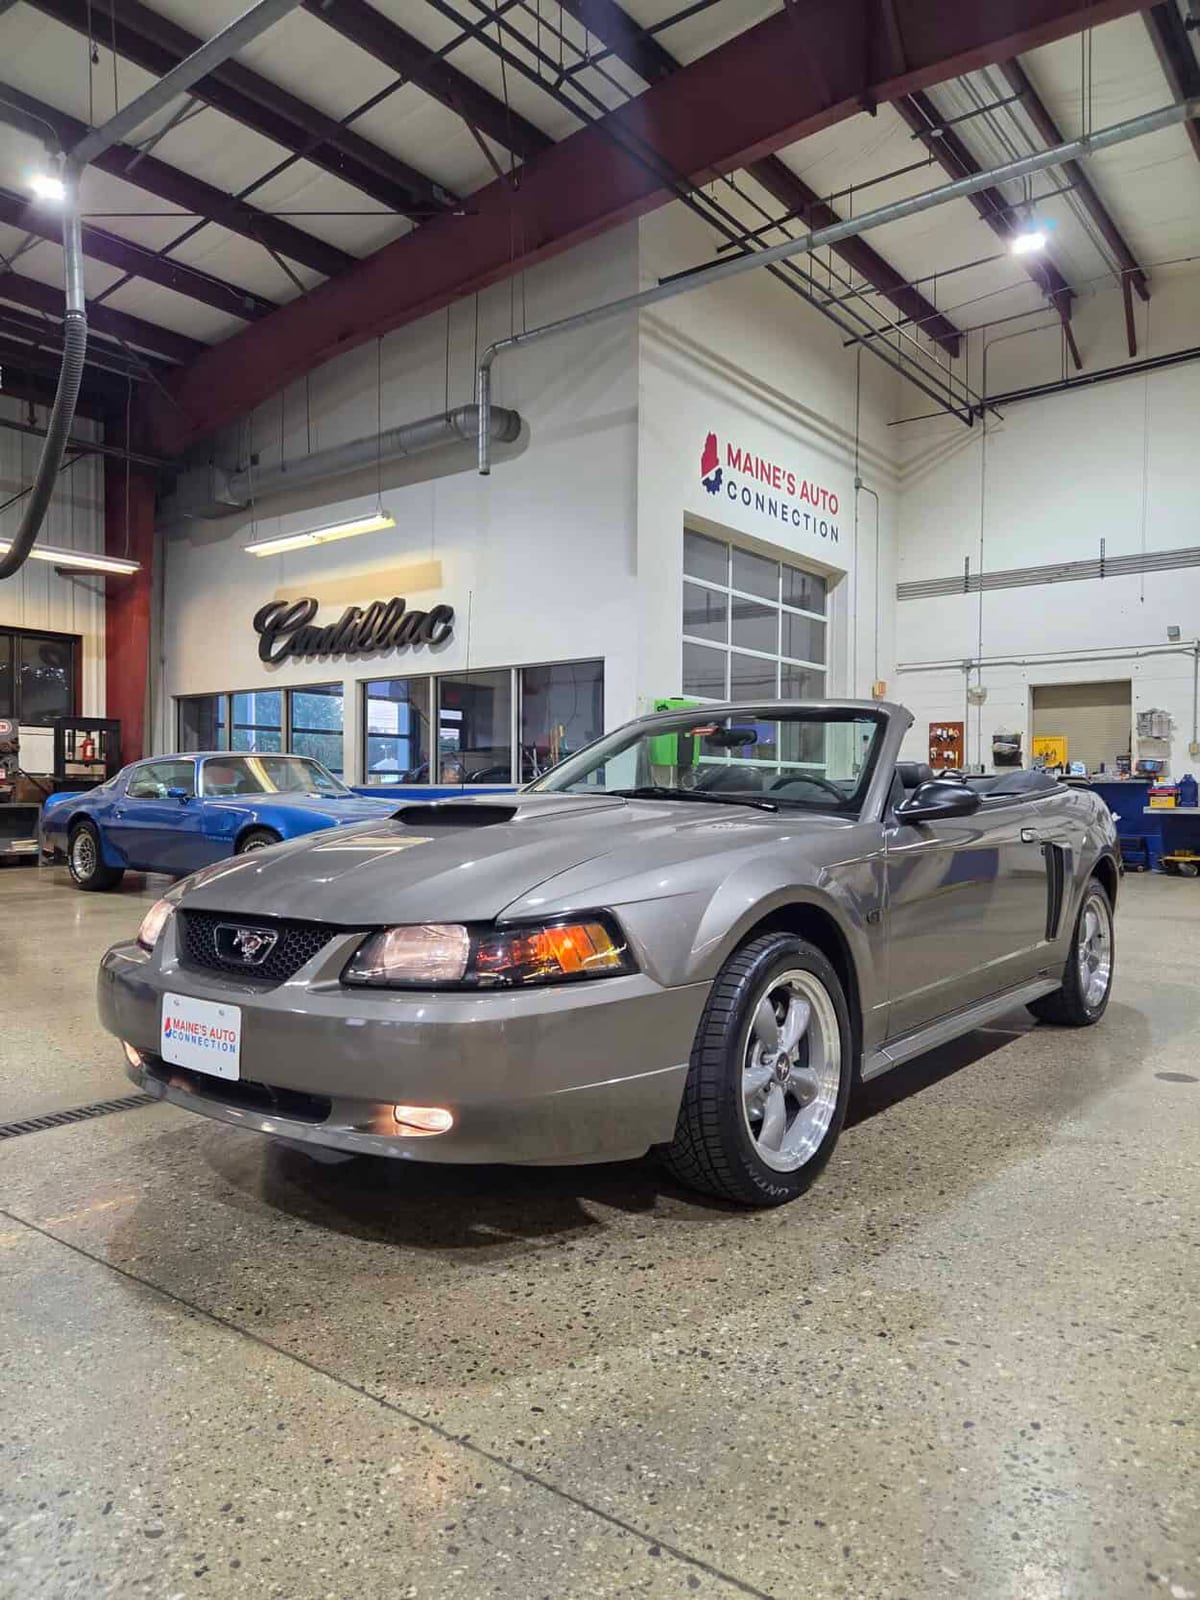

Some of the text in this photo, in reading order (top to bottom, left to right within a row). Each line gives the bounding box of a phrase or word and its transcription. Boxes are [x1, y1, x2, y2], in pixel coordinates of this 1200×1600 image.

[727, 442, 839, 515] MAINE'S AUTO
[727, 480, 839, 543] CONNECTION
[253, 597, 455, 663] Cadillac
[172, 1018, 236, 1043] MAINE'S AUTO
[172, 1030, 236, 1053] CONNECTION
